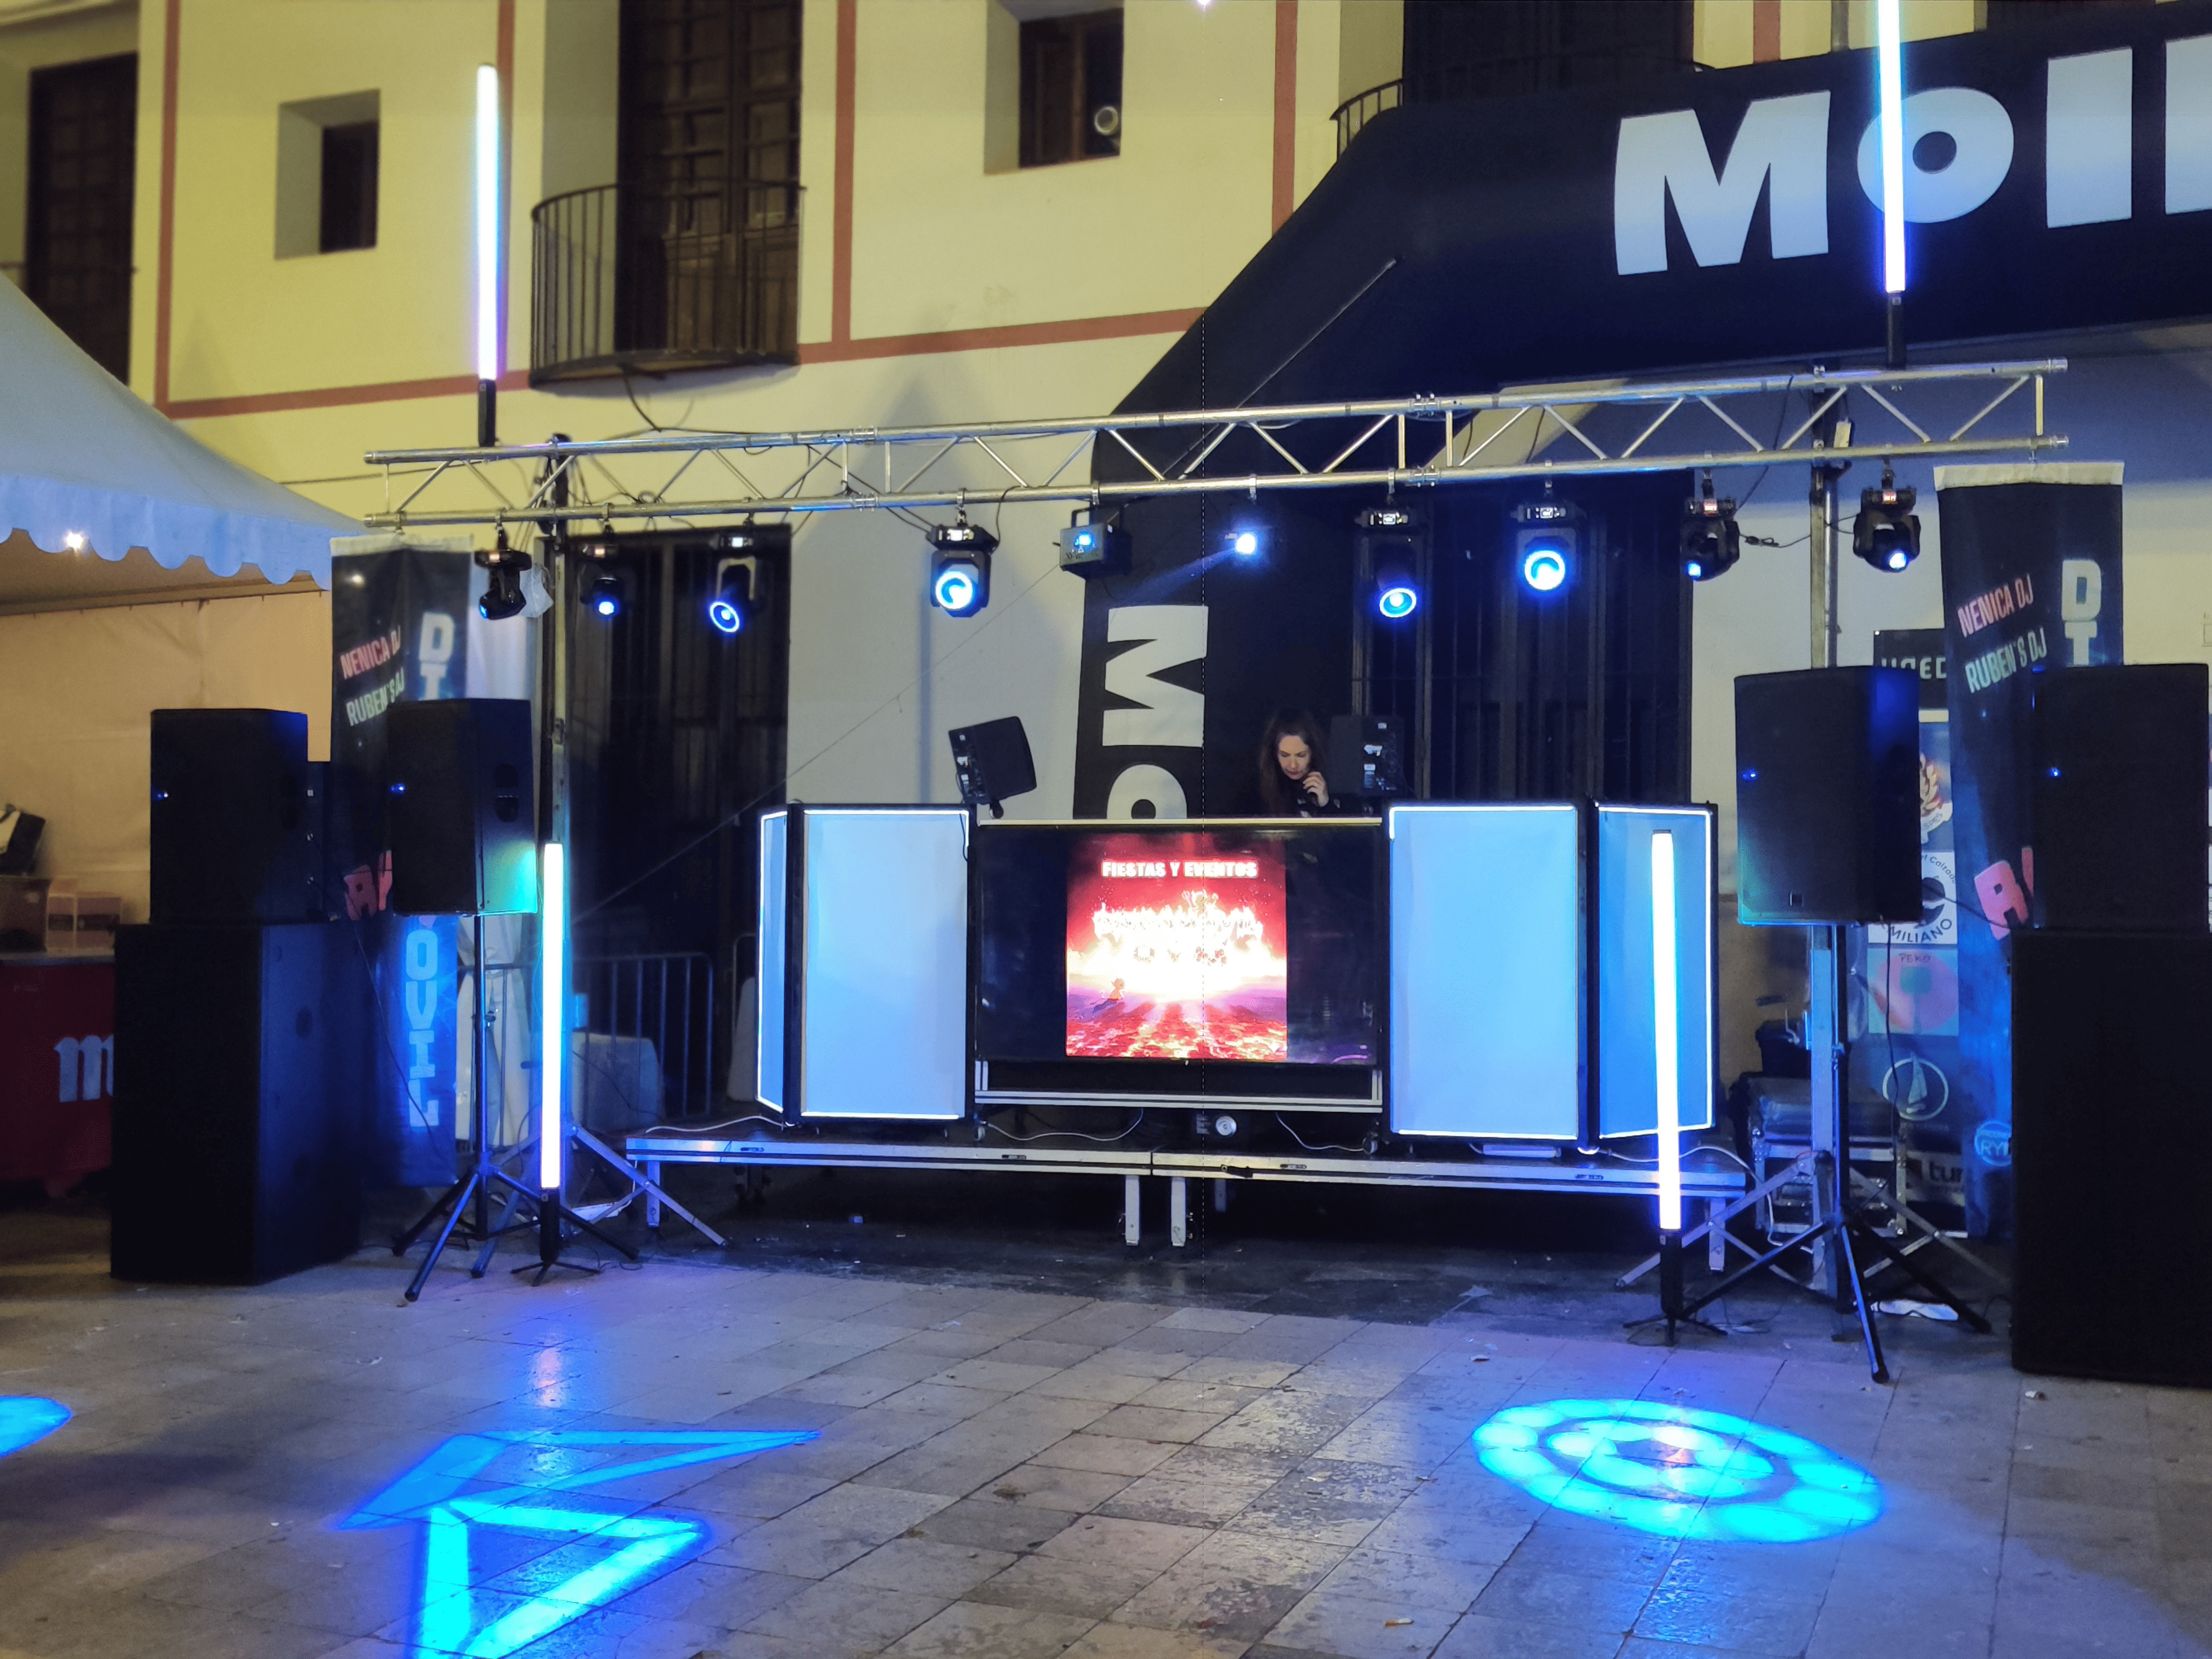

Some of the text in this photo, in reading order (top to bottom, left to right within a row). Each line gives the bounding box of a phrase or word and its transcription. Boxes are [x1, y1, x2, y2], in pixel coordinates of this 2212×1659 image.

[1957, 573, 2034, 638] NENICA DJ
[340, 636, 390, 680] NENICA
[2028, 626, 2047, 662] DJ
[1101, 861, 1258, 878] FIESTAS Y EVENTOS
[1882, 918, 1952, 943] MILIANO
[405, 916, 439, 1127] OVIL
